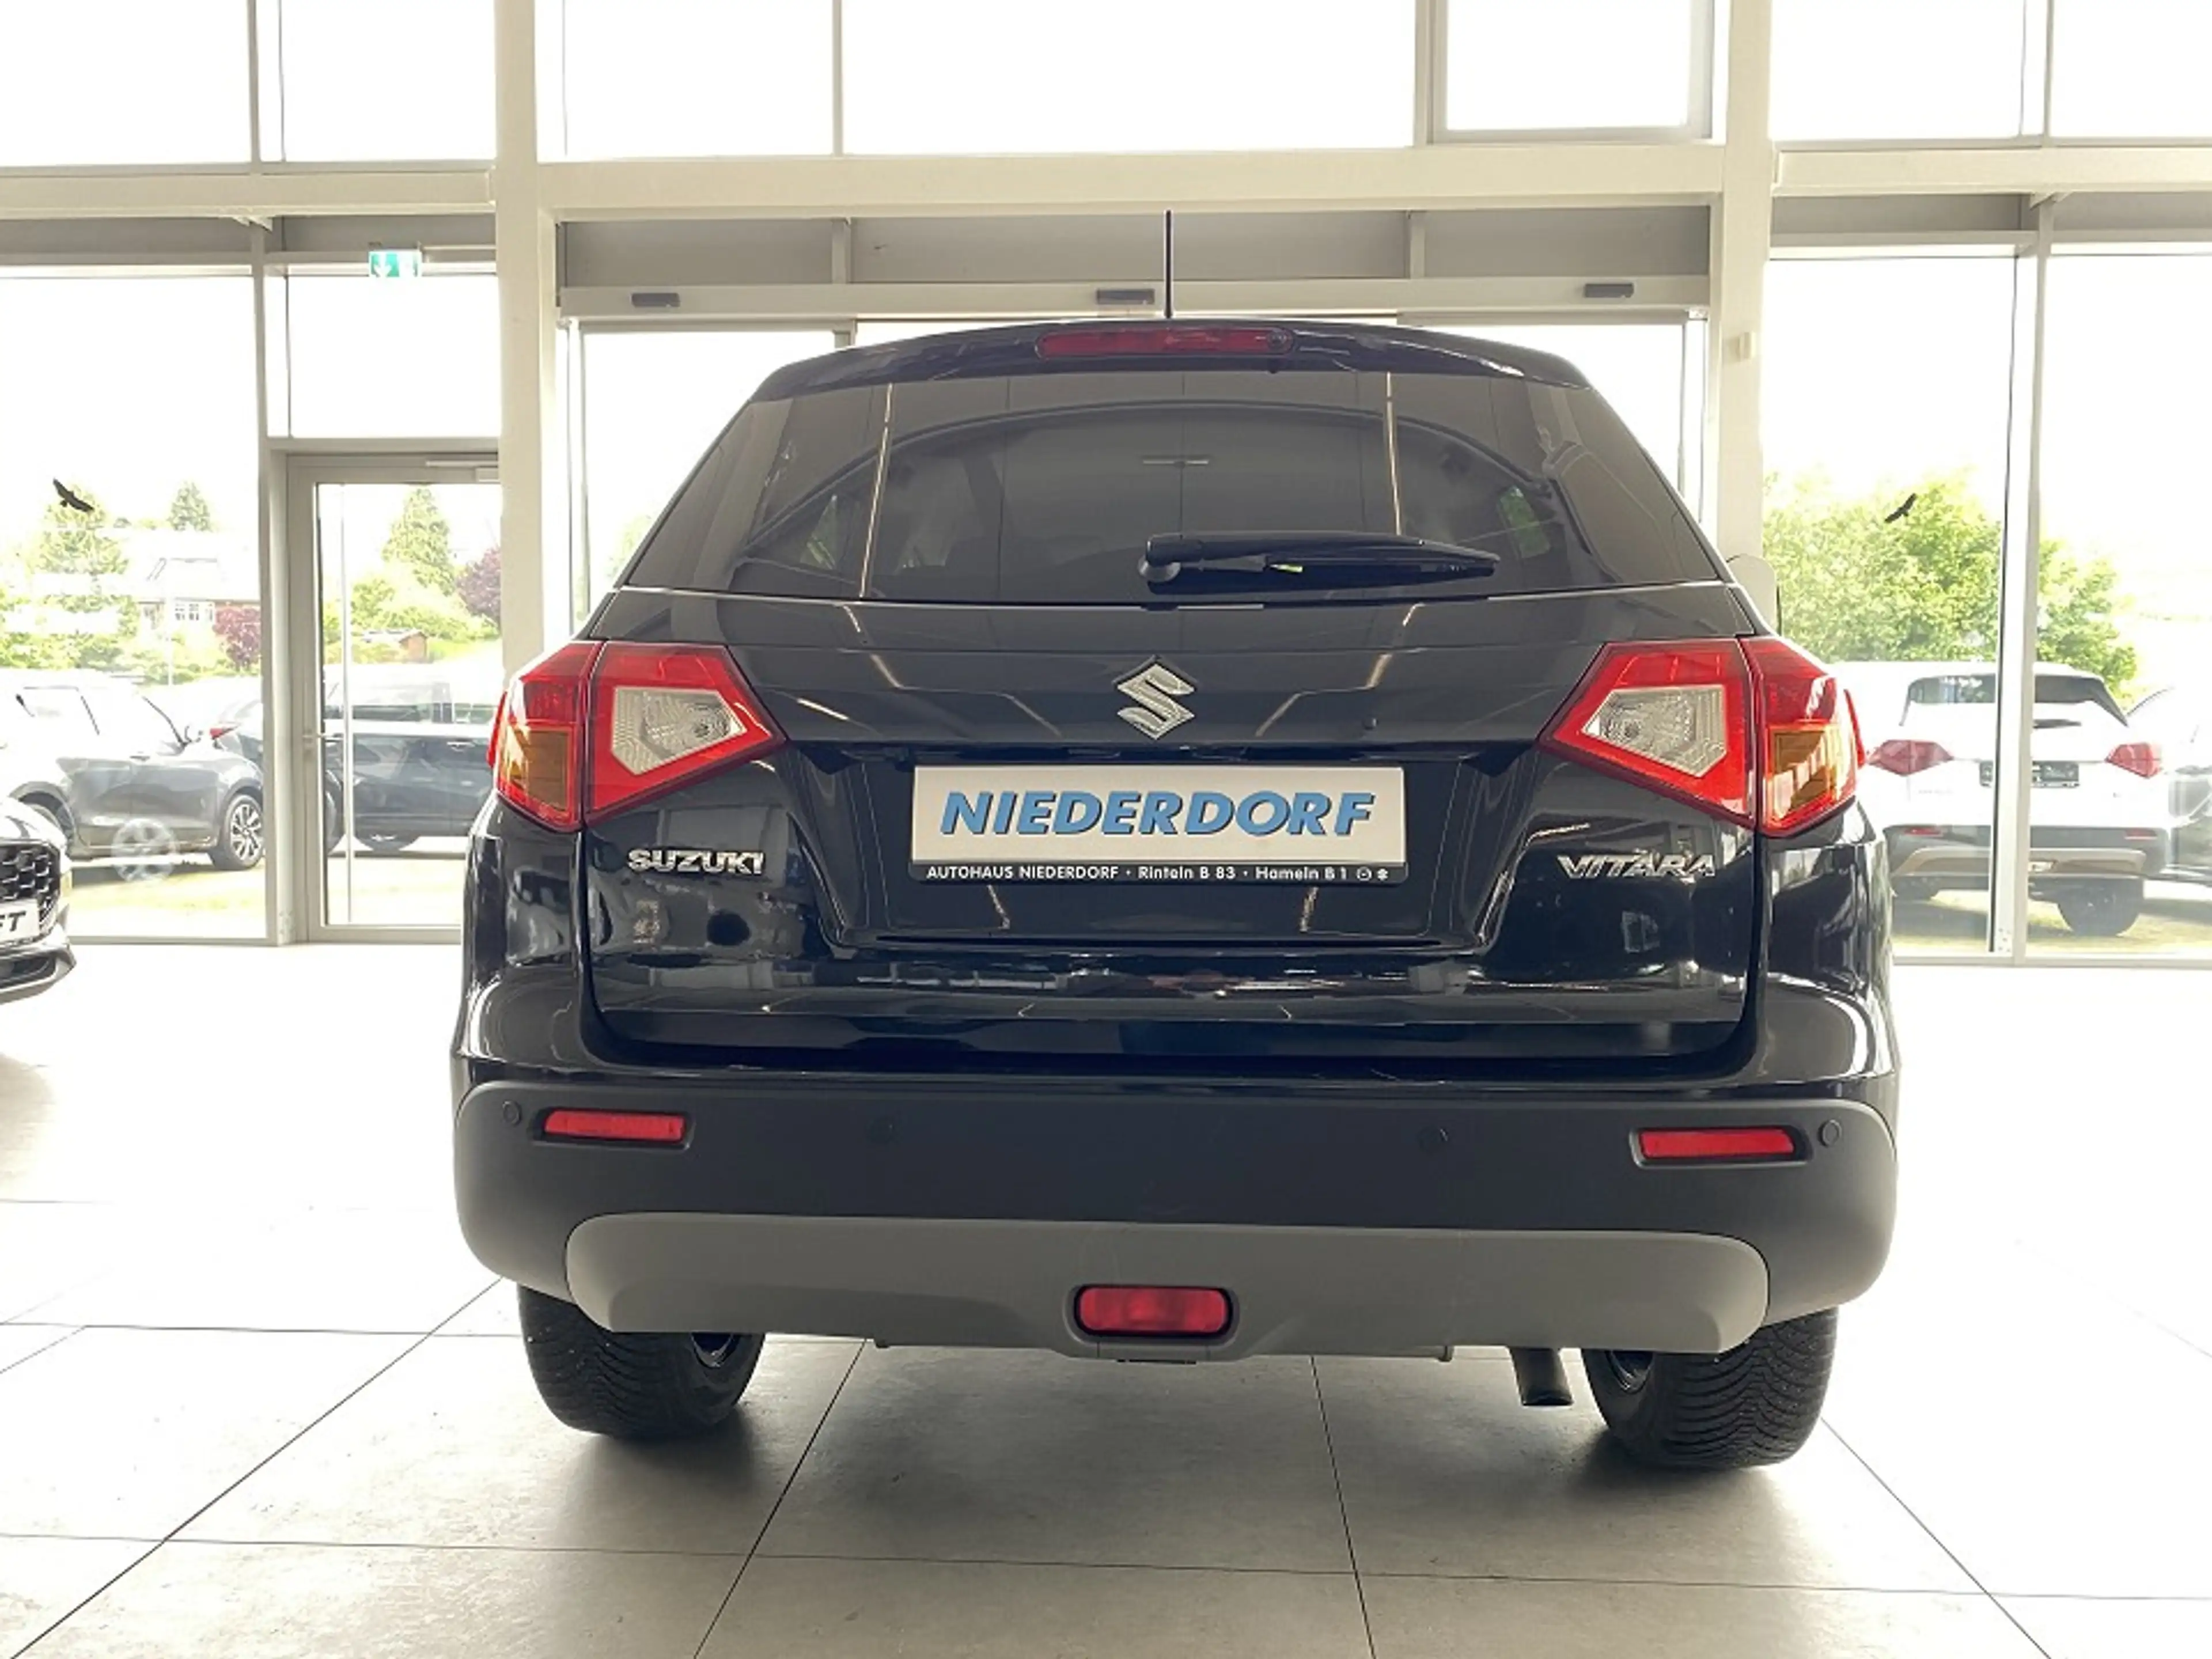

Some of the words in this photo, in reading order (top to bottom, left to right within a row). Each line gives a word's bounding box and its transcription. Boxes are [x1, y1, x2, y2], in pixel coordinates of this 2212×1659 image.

[940, 790, 1376, 837] NIEDERDORF
[627, 848, 764, 874] SUZUKI
[926, 866, 1014, 880] AUTOHAUS
[1018, 866, 1119, 880] NIEDERDORF
[1199, 866, 1210, 879] B
[1215, 866, 1237, 880] 83
[1255, 866, 1320, 881] Hameln
[1339, 866, 1347, 880] 1
[1556, 853, 1715, 879] VITARA
